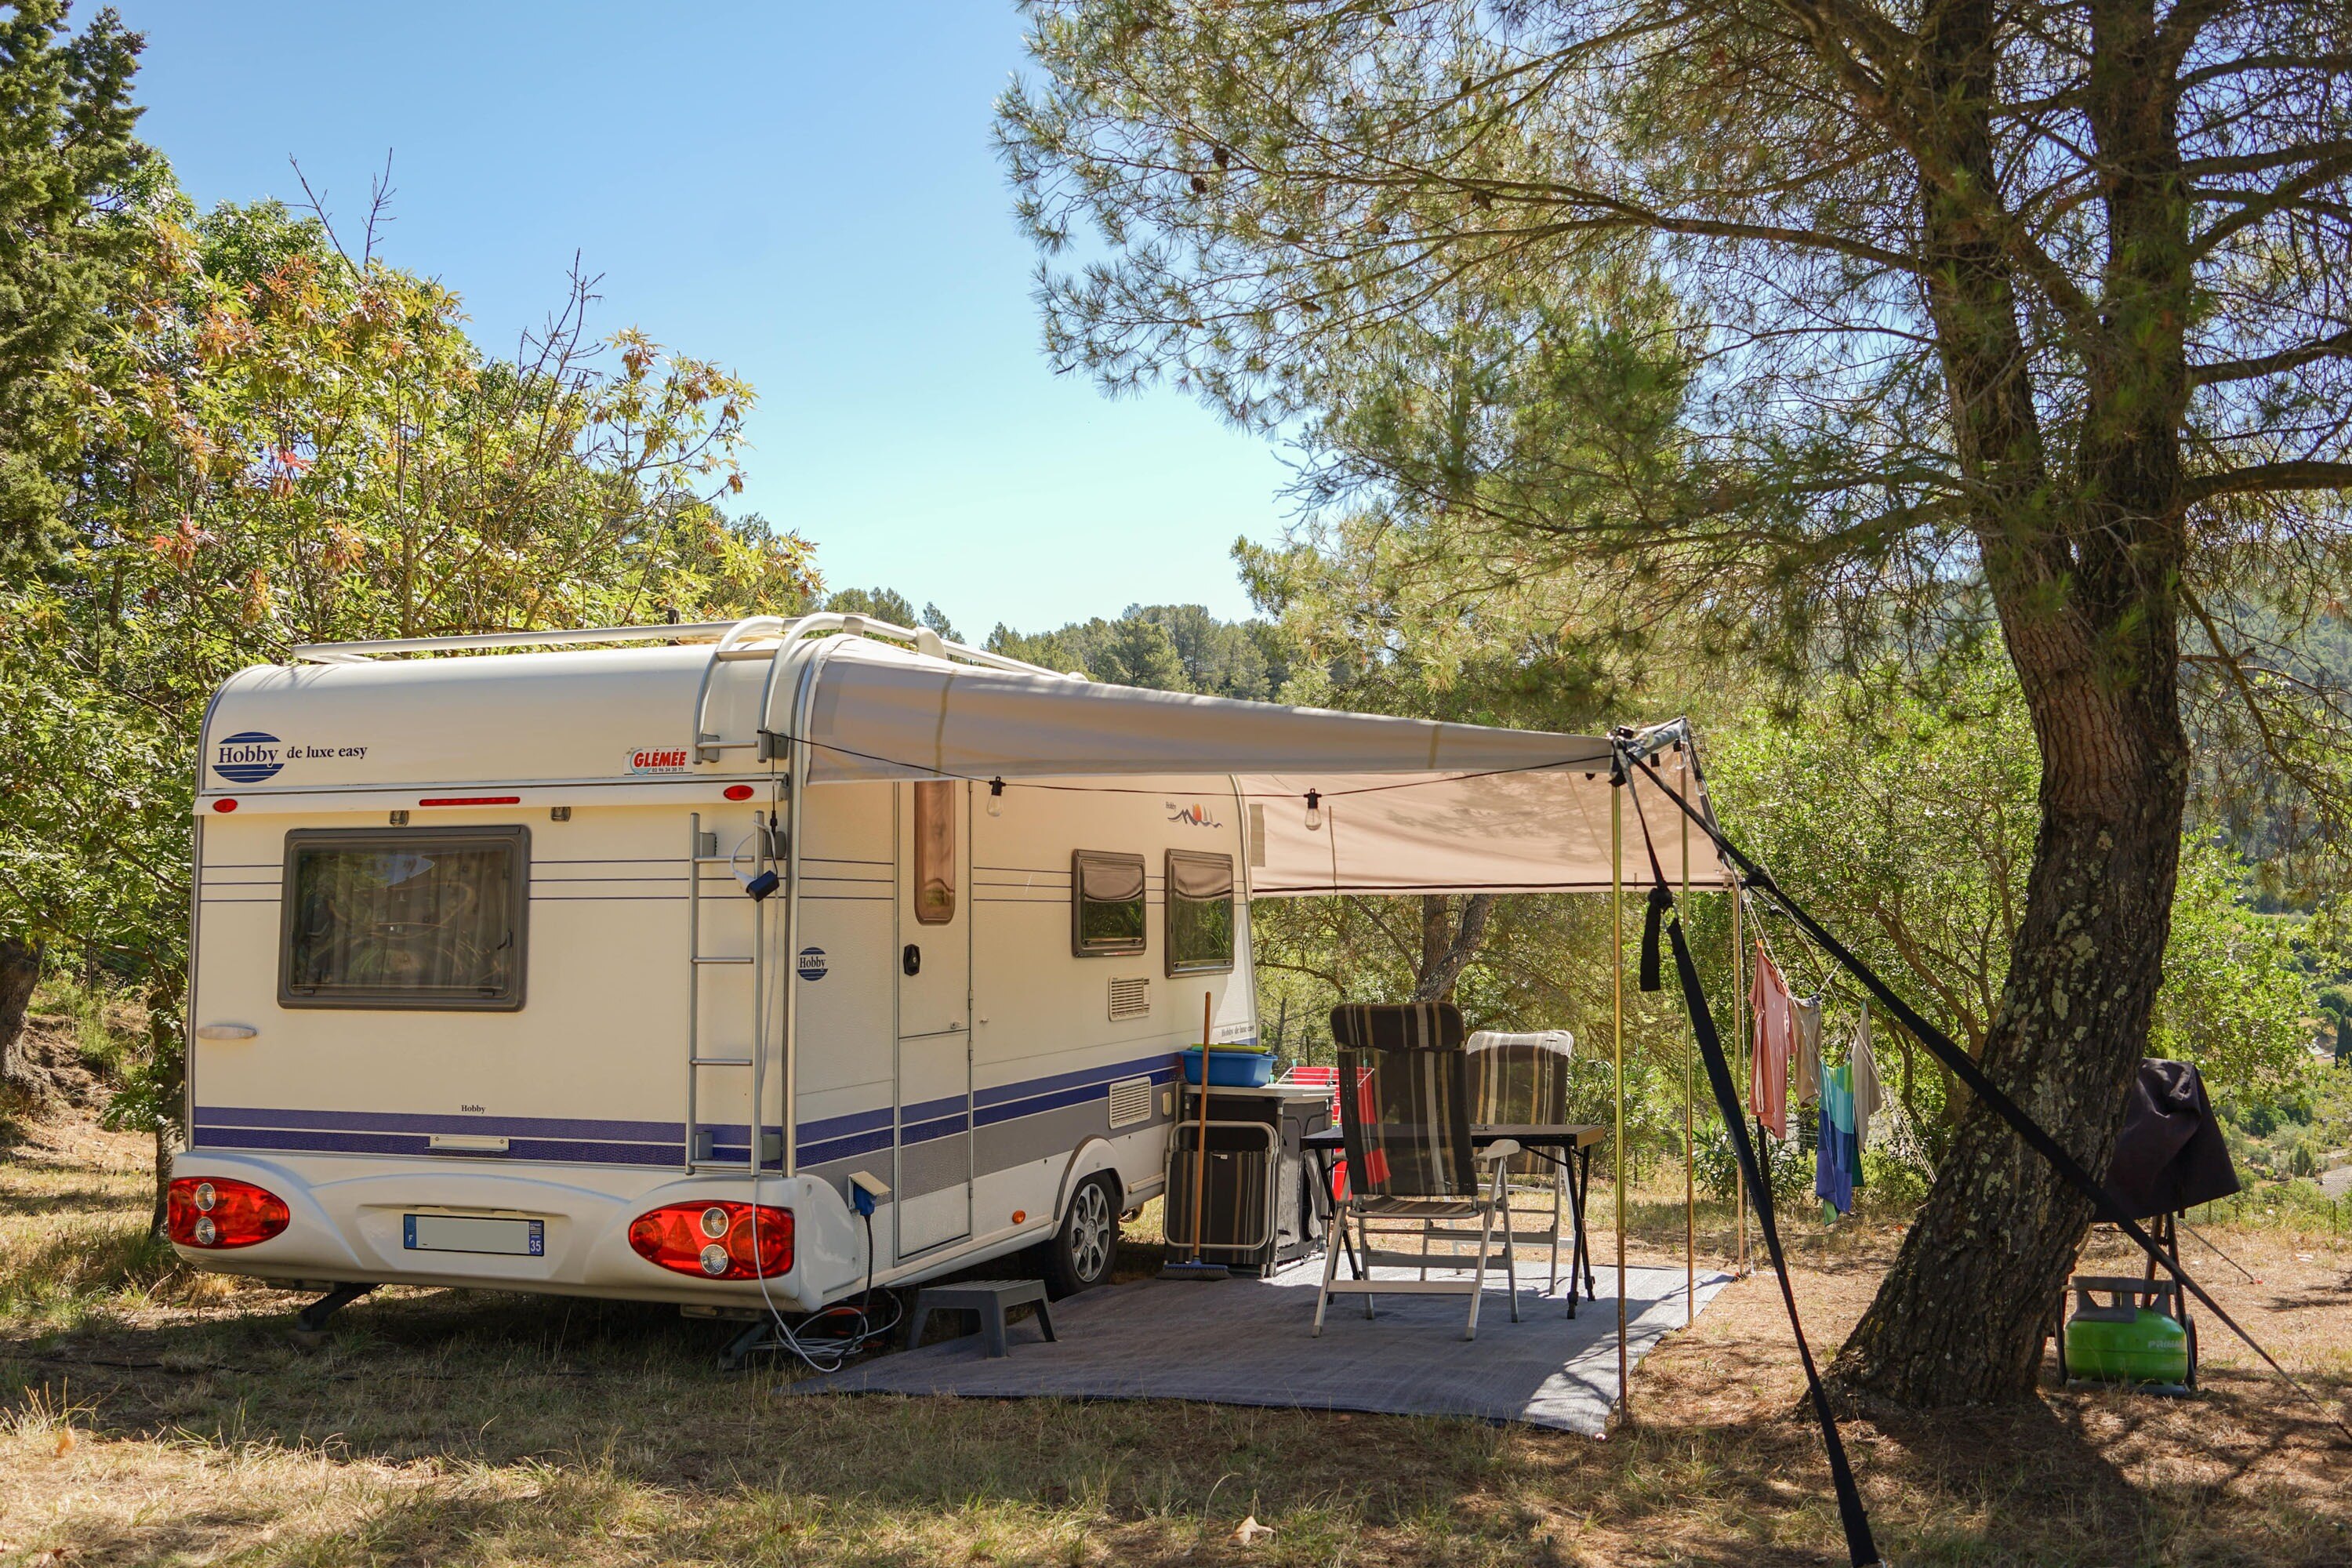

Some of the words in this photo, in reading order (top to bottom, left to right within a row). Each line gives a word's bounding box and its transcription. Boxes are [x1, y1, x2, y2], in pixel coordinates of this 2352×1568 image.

[219, 745, 279, 767] Hobby
[287, 746, 303, 759] de
[307, 746, 334, 758] luxe
[339, 747, 368, 760] easy
[633, 748, 687, 768] GLÉMÉE
[800, 956, 826, 971] Hobby
[461, 1104, 486, 1114] Hobby
[530, 1240, 541, 1252] 35
